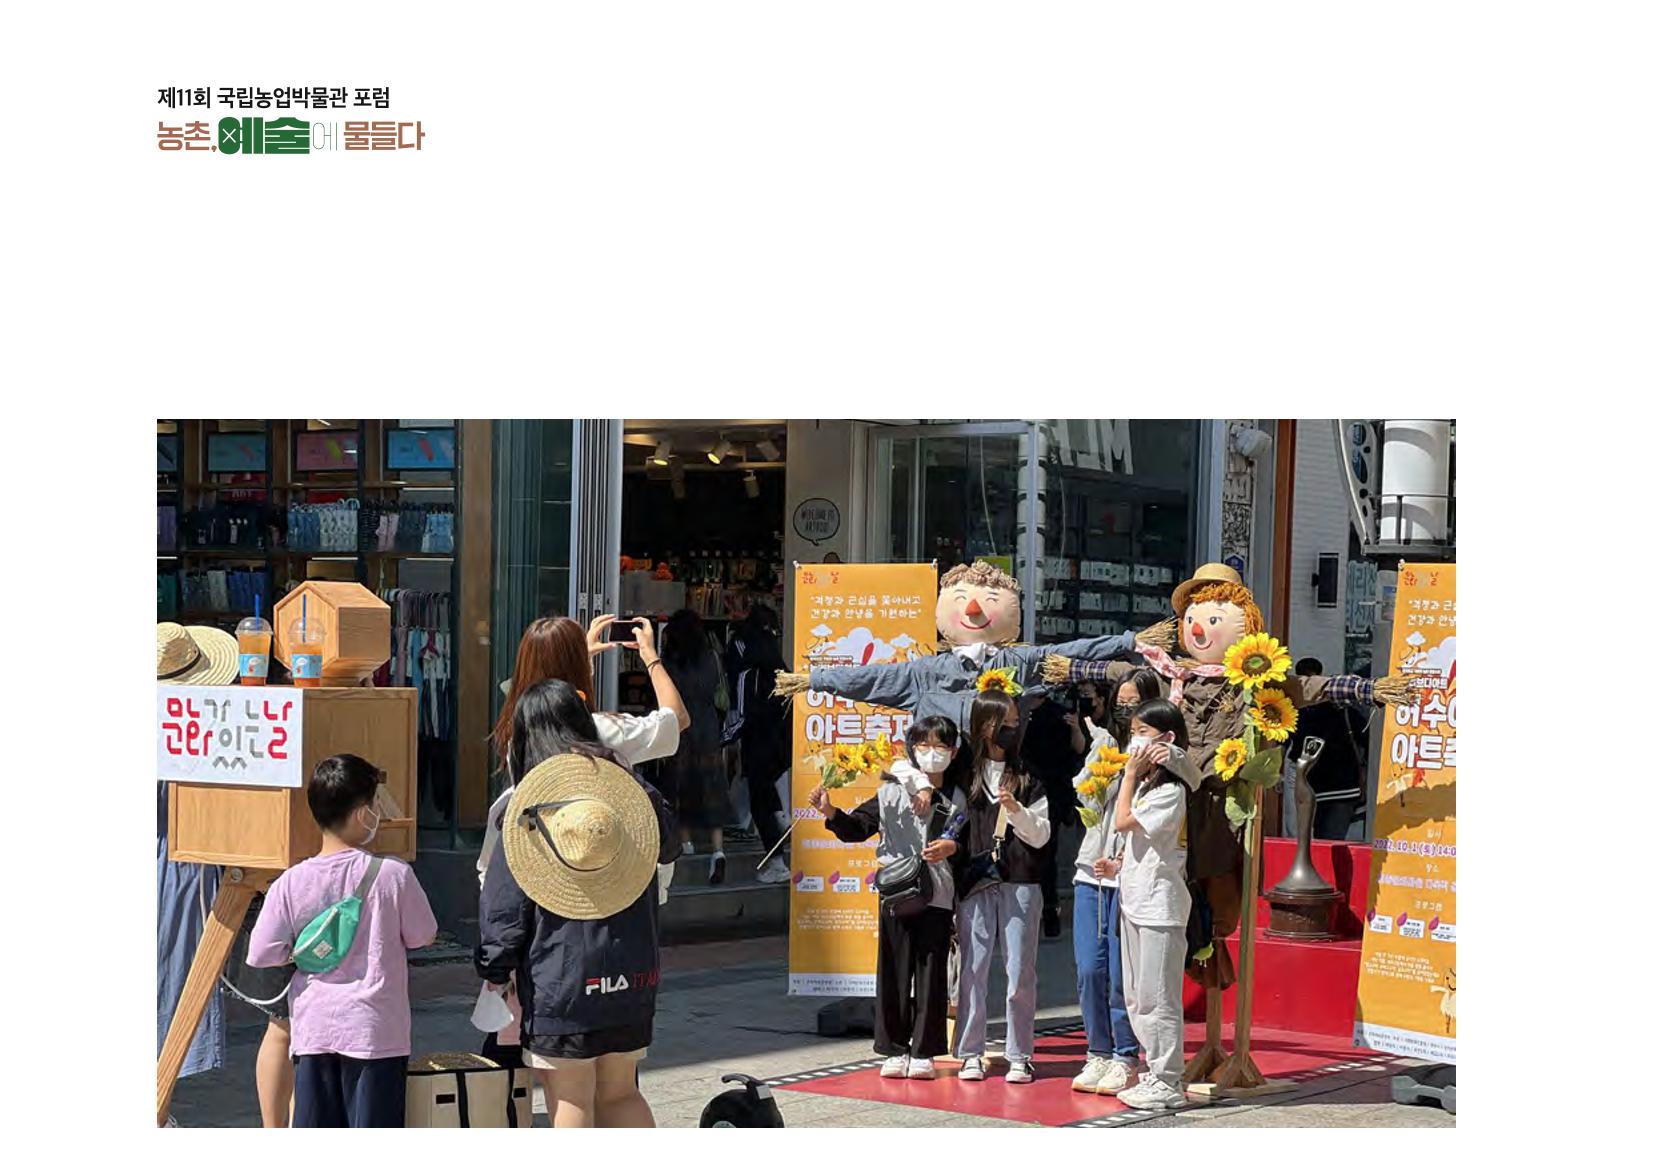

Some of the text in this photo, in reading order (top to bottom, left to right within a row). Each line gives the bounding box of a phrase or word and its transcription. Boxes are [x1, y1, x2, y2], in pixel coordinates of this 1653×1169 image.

[158, 87, 390, 109] 제11회 국립농업박물관 포럼
[157, 121, 217, 153] 농촌,
[344, 121, 426, 151] 물들다
[585, 974, 629, 996] FILA
